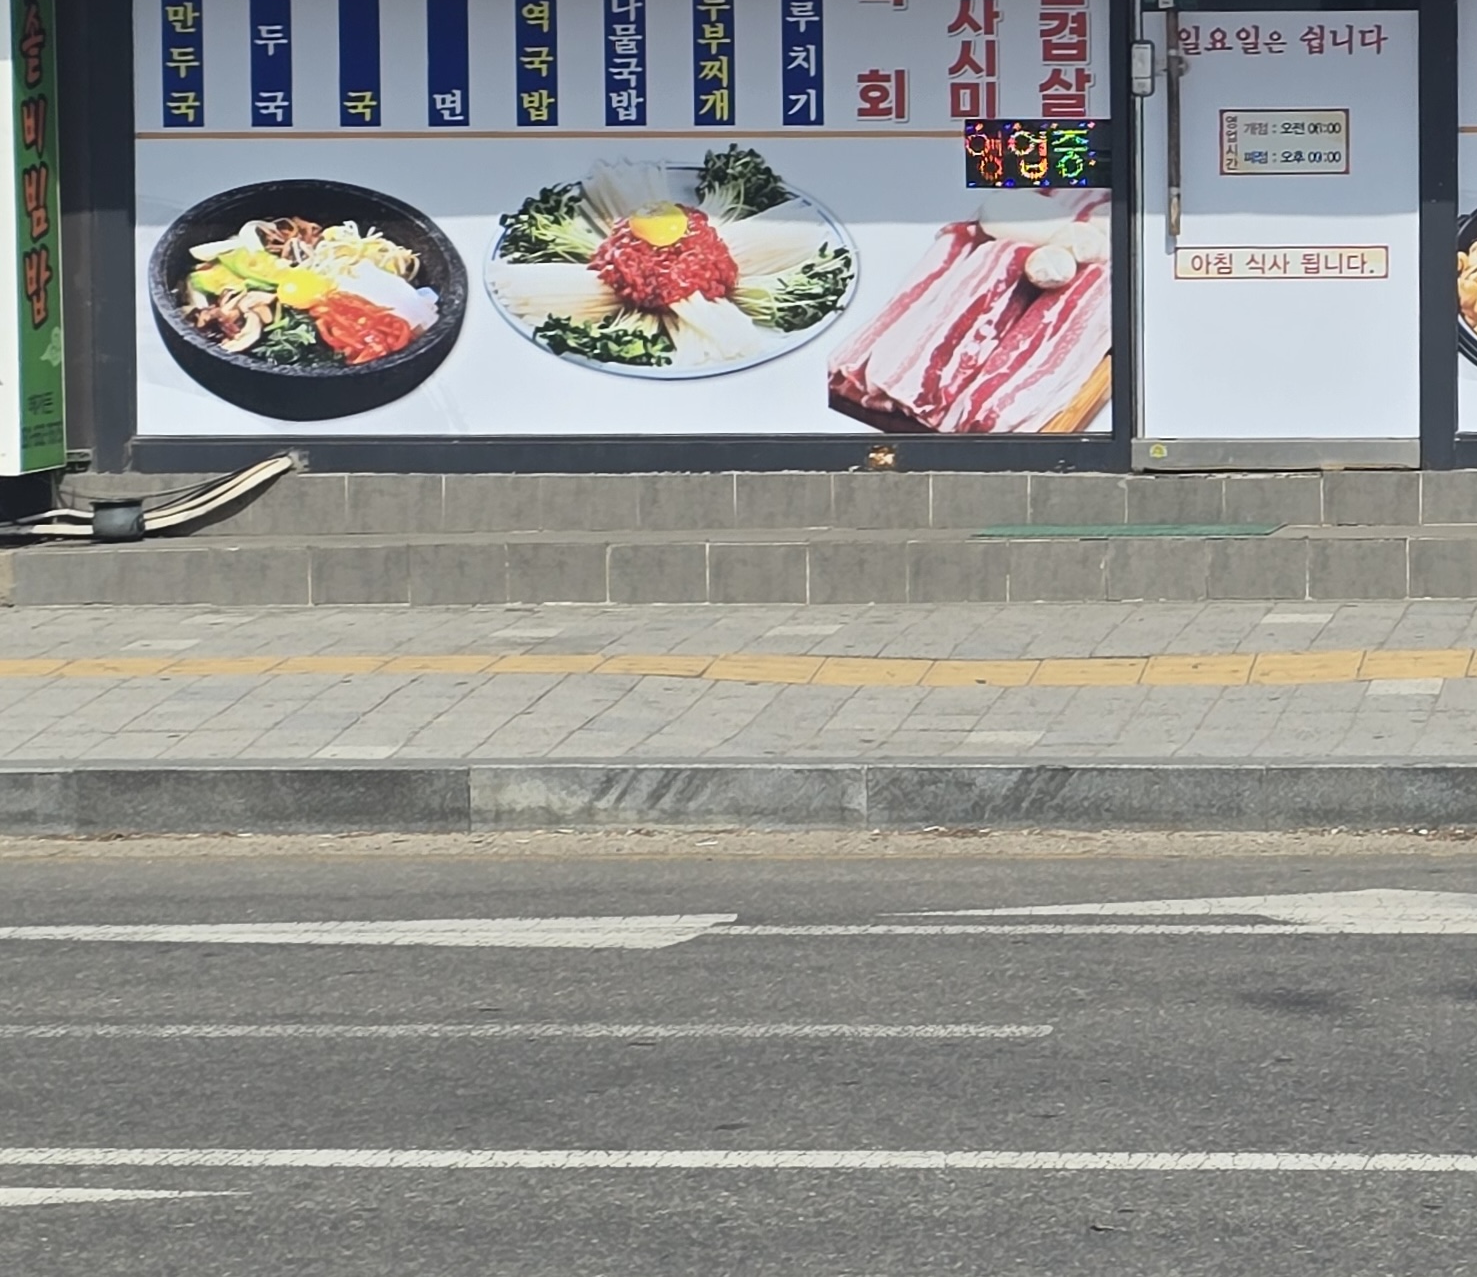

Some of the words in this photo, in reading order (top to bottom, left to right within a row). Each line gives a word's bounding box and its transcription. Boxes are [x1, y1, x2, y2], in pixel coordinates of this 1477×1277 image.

[1178, 25, 1288, 56] 일요일은
[1299, 24, 1390, 56] 쉽니다
[1243, 123, 1269, 136] 개점
[1279, 122, 1306, 135] 오전
[965, 129, 1089, 181] 영업중
[1225, 115, 1238, 171] 영업시간
[1279, 151, 1306, 163] 오후
[1190, 253, 1234, 275] 아침
[1245, 253, 1290, 275] 식사
[1301, 252, 1375, 275] 됩니다.
